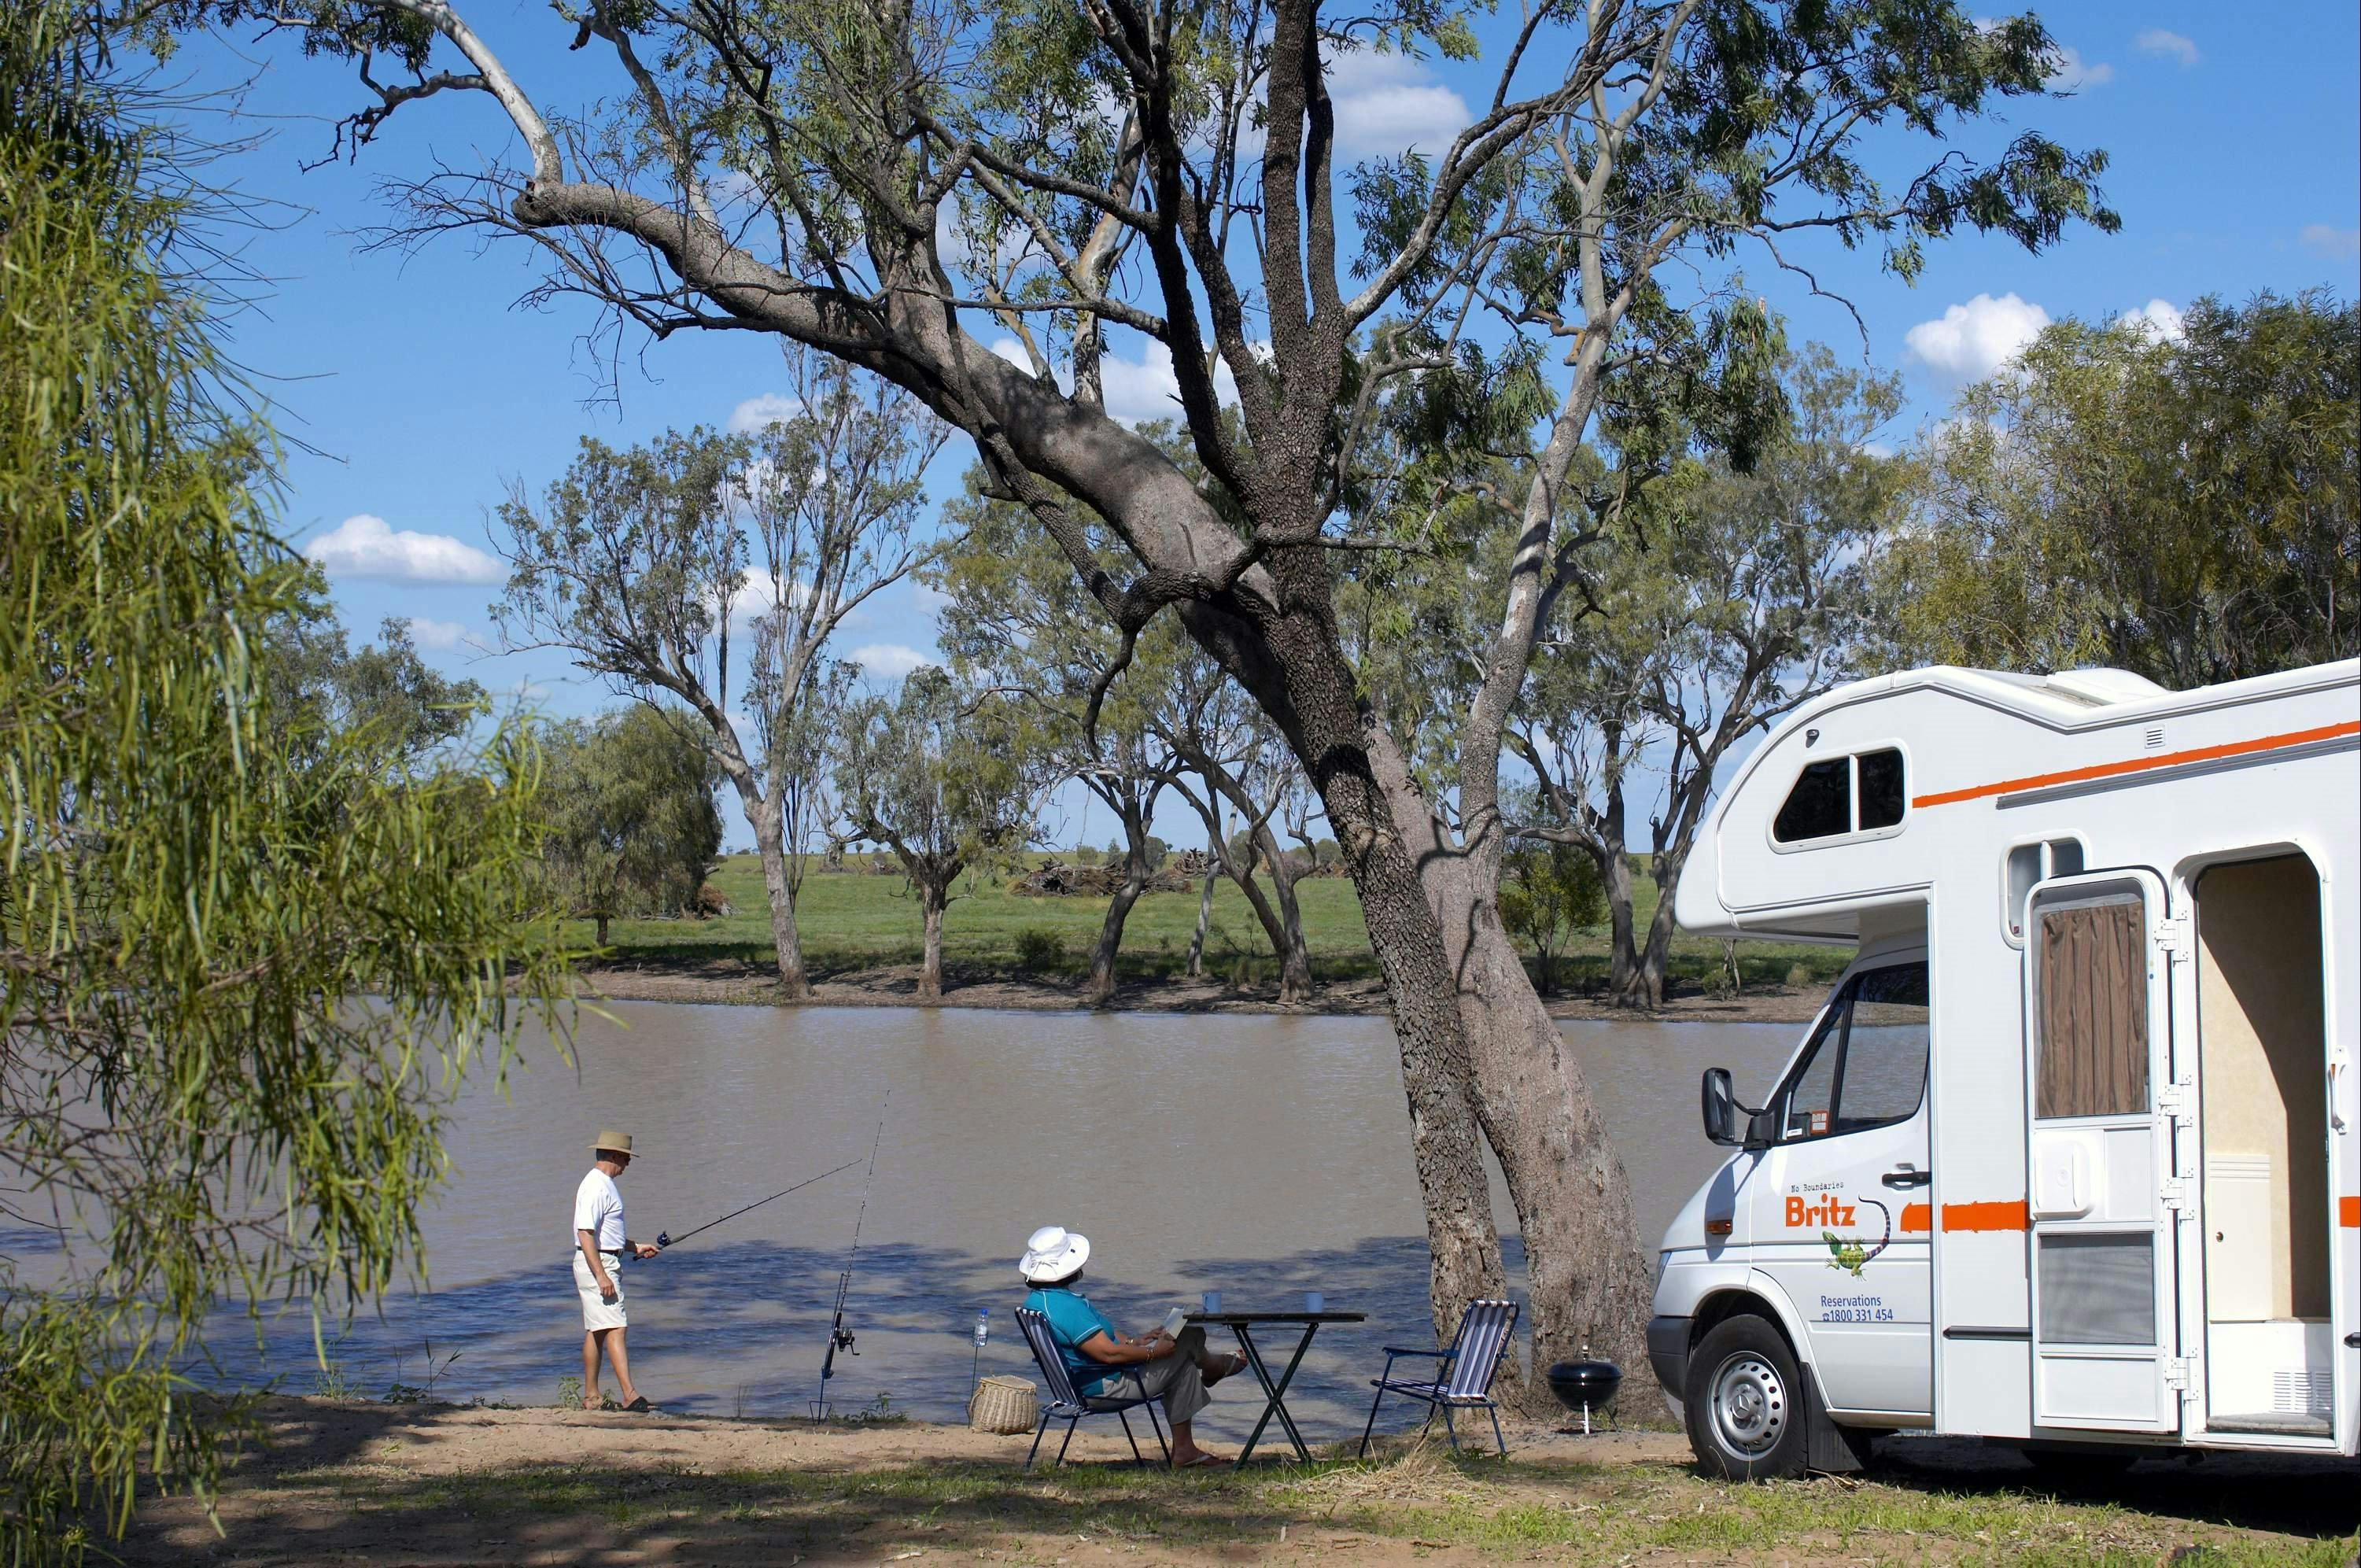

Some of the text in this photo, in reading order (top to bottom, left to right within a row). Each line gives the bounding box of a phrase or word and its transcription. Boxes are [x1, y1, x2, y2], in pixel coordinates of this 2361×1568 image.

[1803, 1182, 1844, 1192] Boundaries
[1785, 1193, 1855, 1227] Britz
[1821, 1294, 1882, 1308] Reservations
[1830, 1308, 1894, 1322] 1800 331 454
